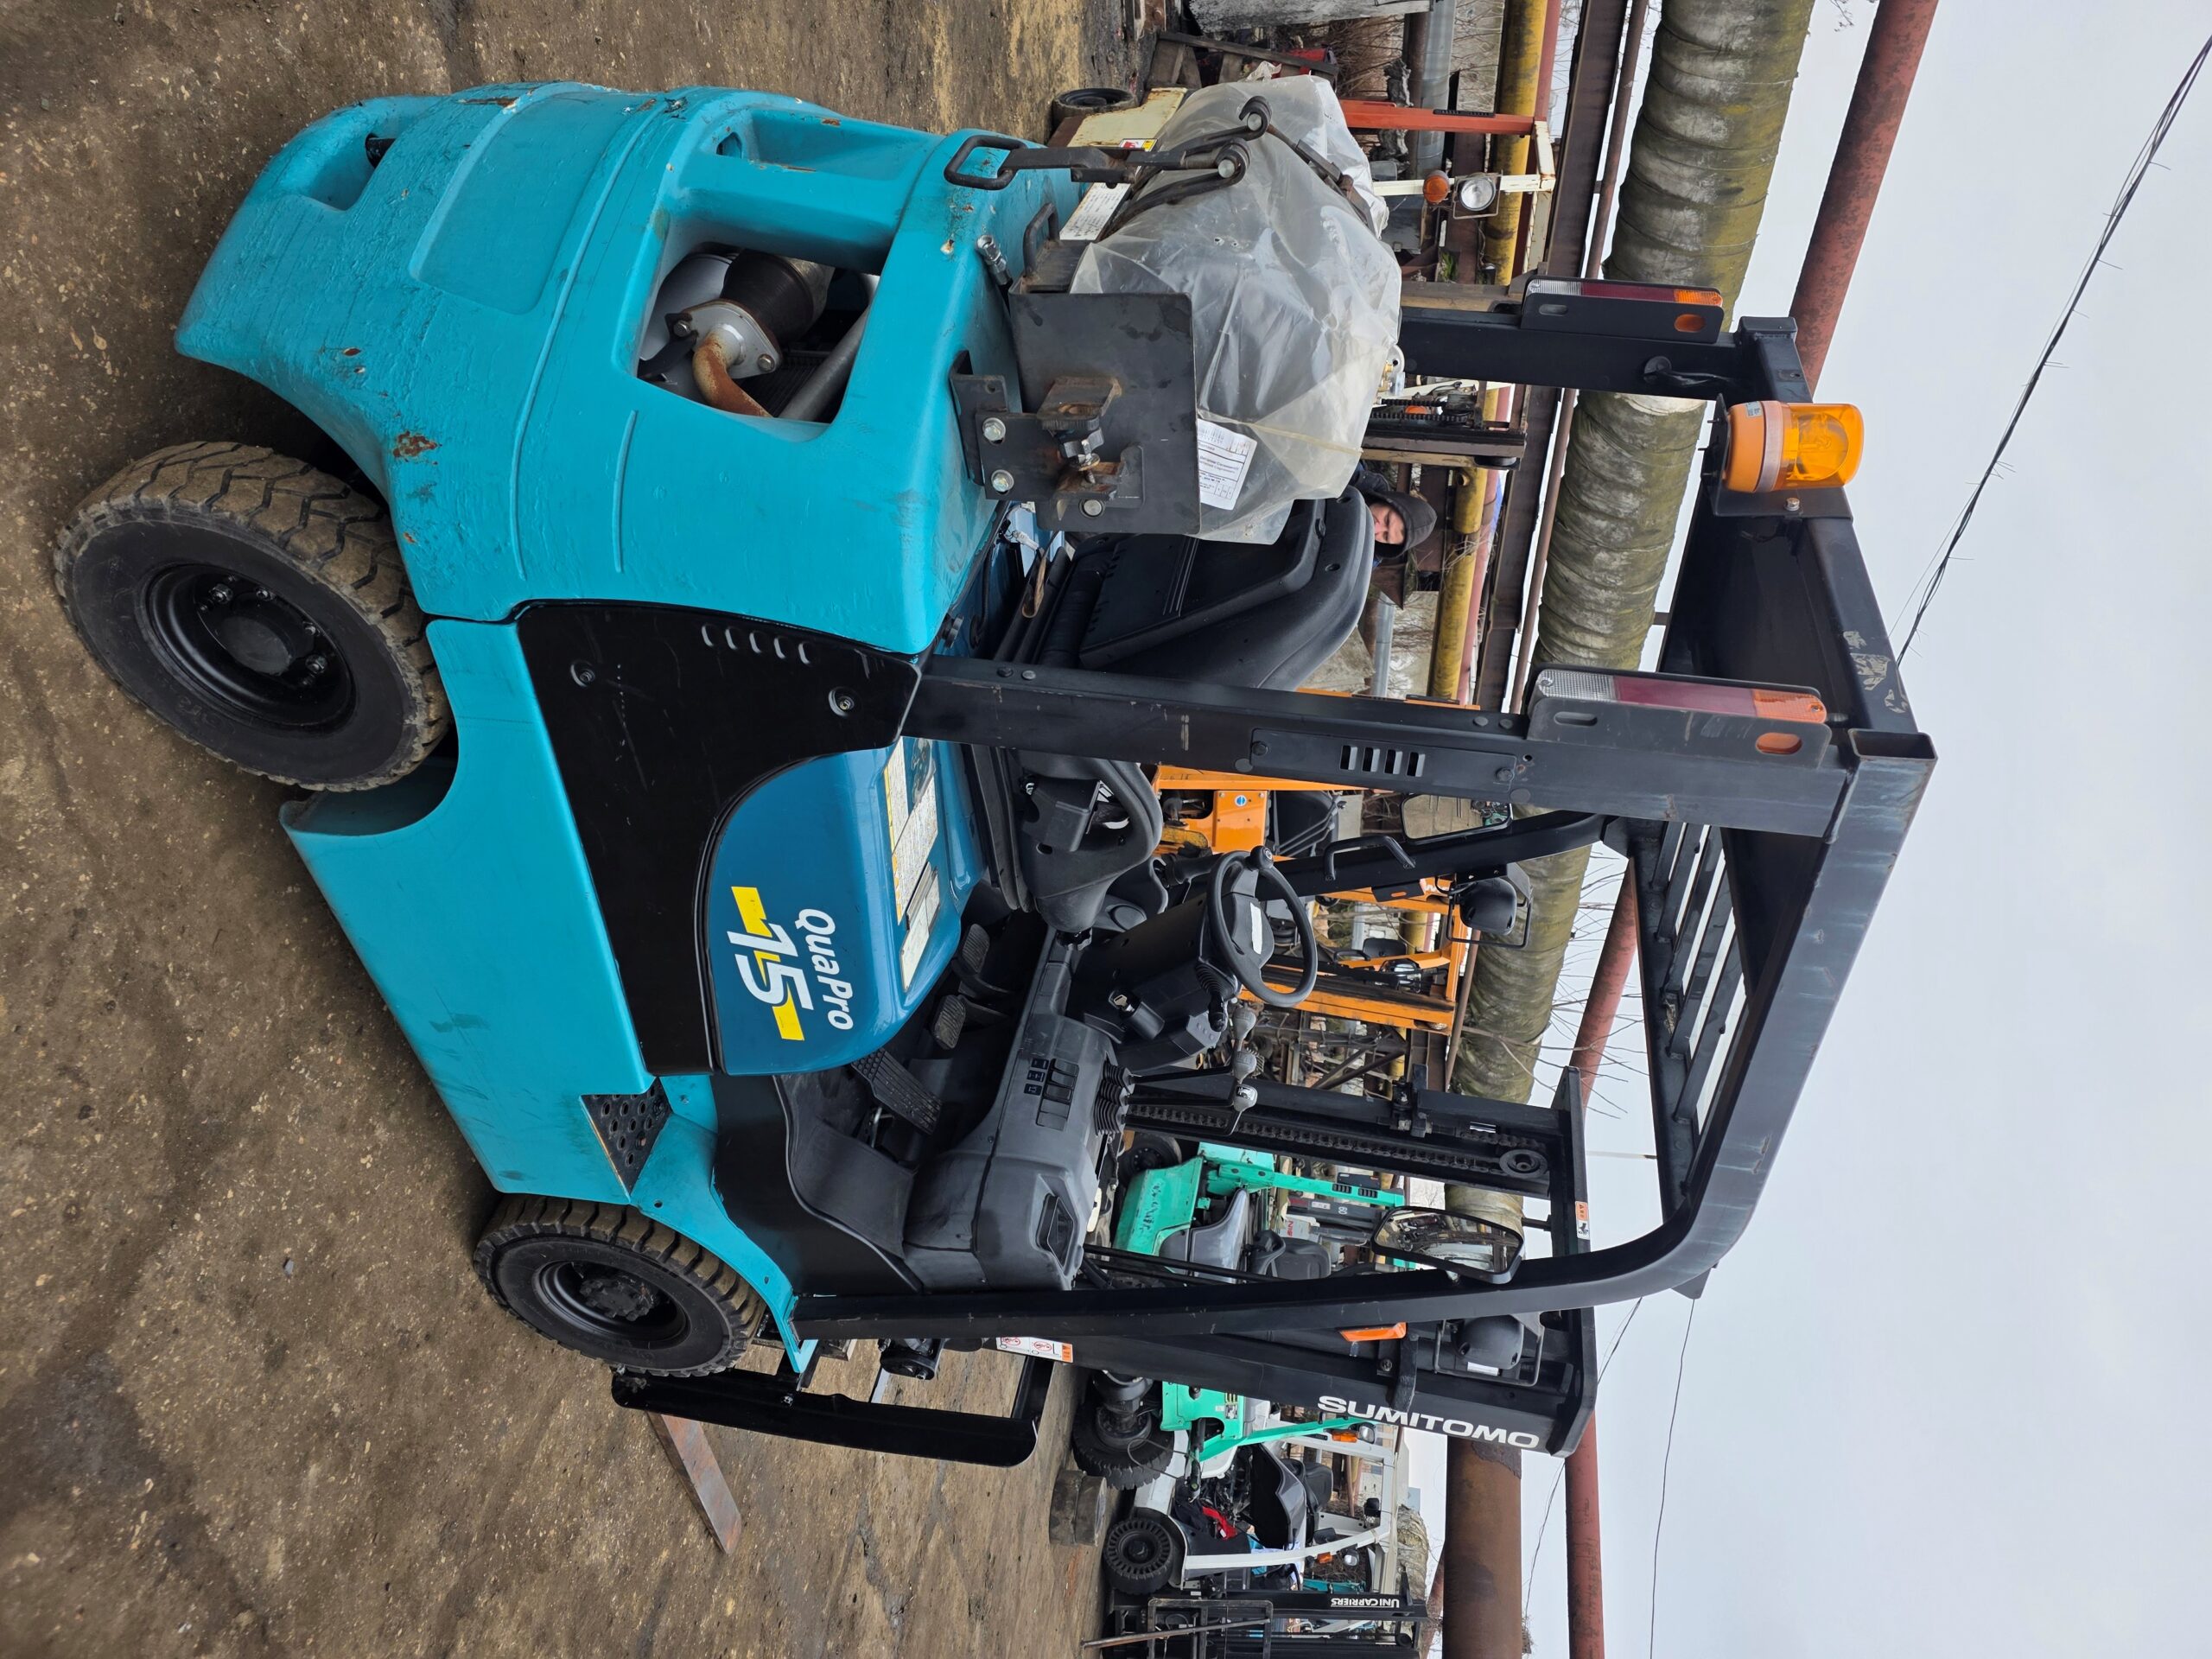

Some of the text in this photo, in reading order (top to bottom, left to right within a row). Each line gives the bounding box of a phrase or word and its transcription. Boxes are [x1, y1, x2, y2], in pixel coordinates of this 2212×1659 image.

[727, 923, 814, 1011] 15
[795, 909, 853, 1030] QuaPro
[1338, 1206, 1348, 1215] 60
[1317, 1395, 1540, 1448] SUMITOMO
